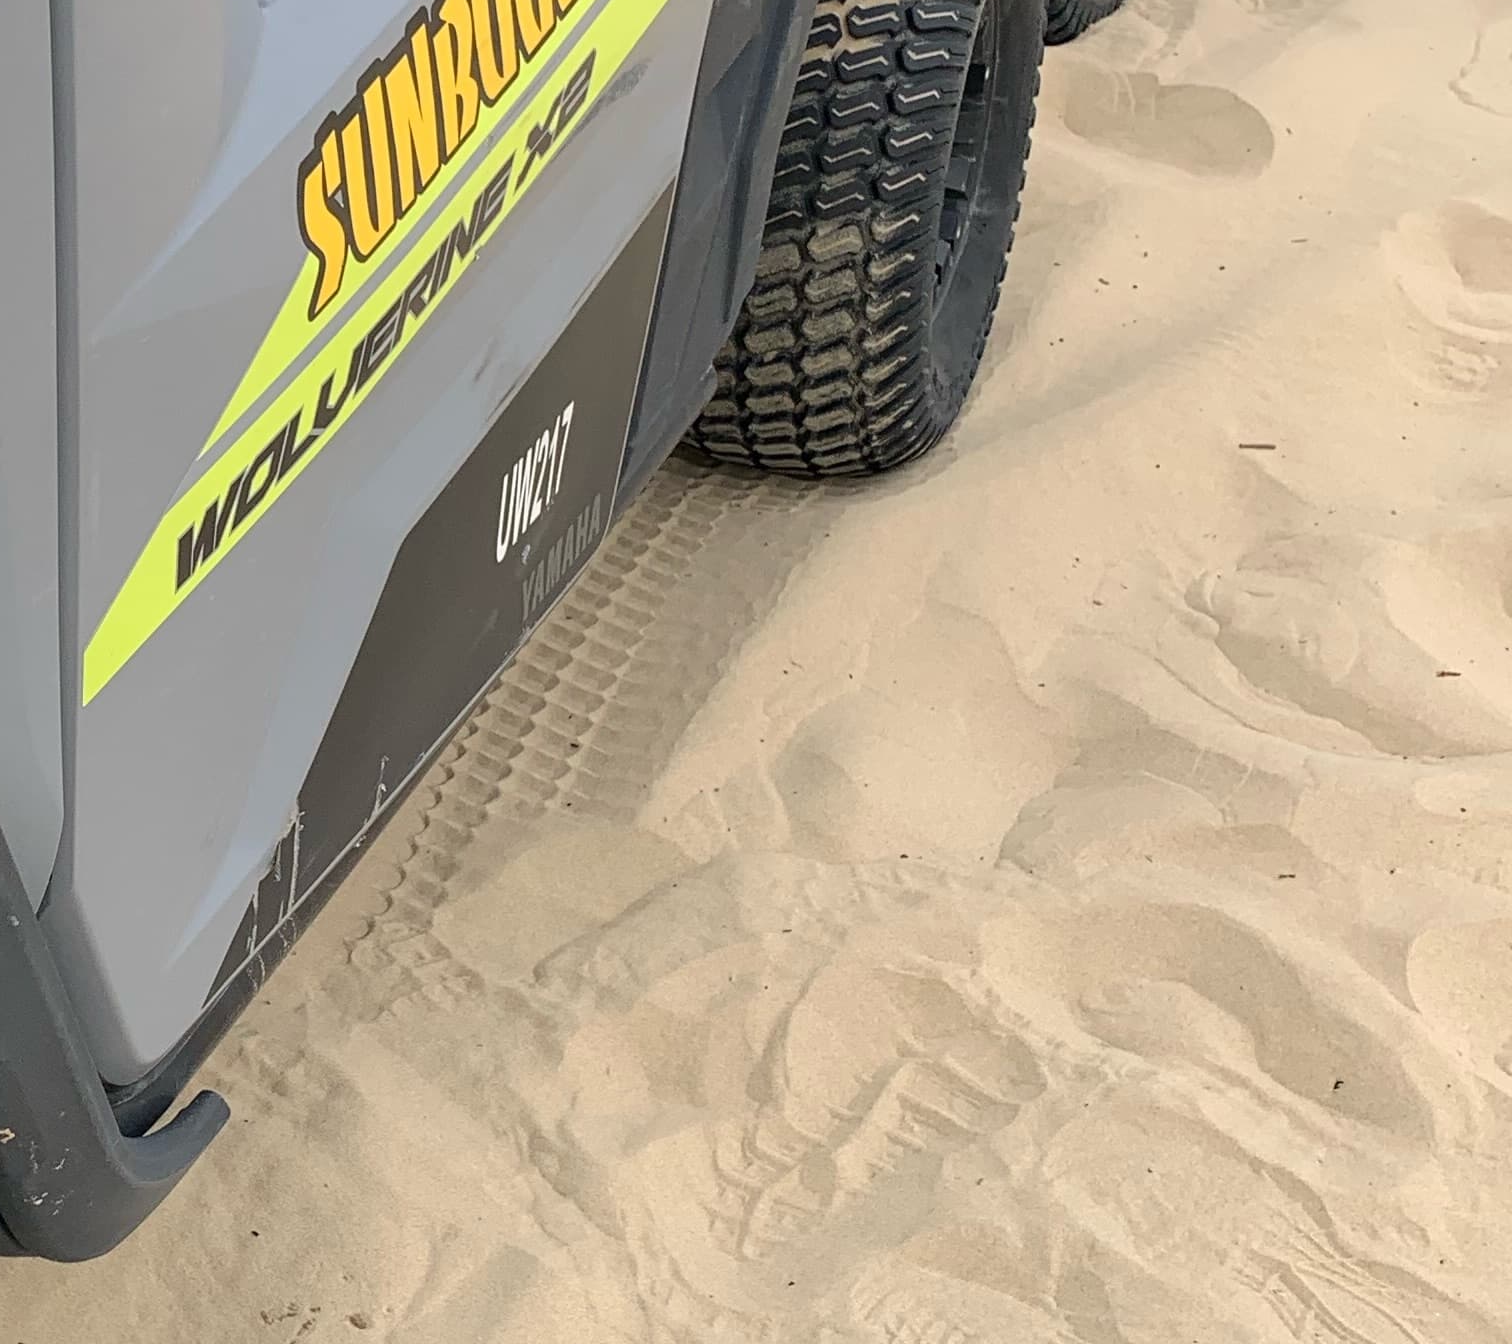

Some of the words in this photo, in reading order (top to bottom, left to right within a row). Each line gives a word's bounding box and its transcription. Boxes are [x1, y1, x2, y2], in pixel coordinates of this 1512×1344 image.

[174, 151, 517, 594] WOLVERINE
[514, 48, 597, 197] X2
[496, 400, 575, 564] UW217
[522, 493, 601, 622] YAMAHA
